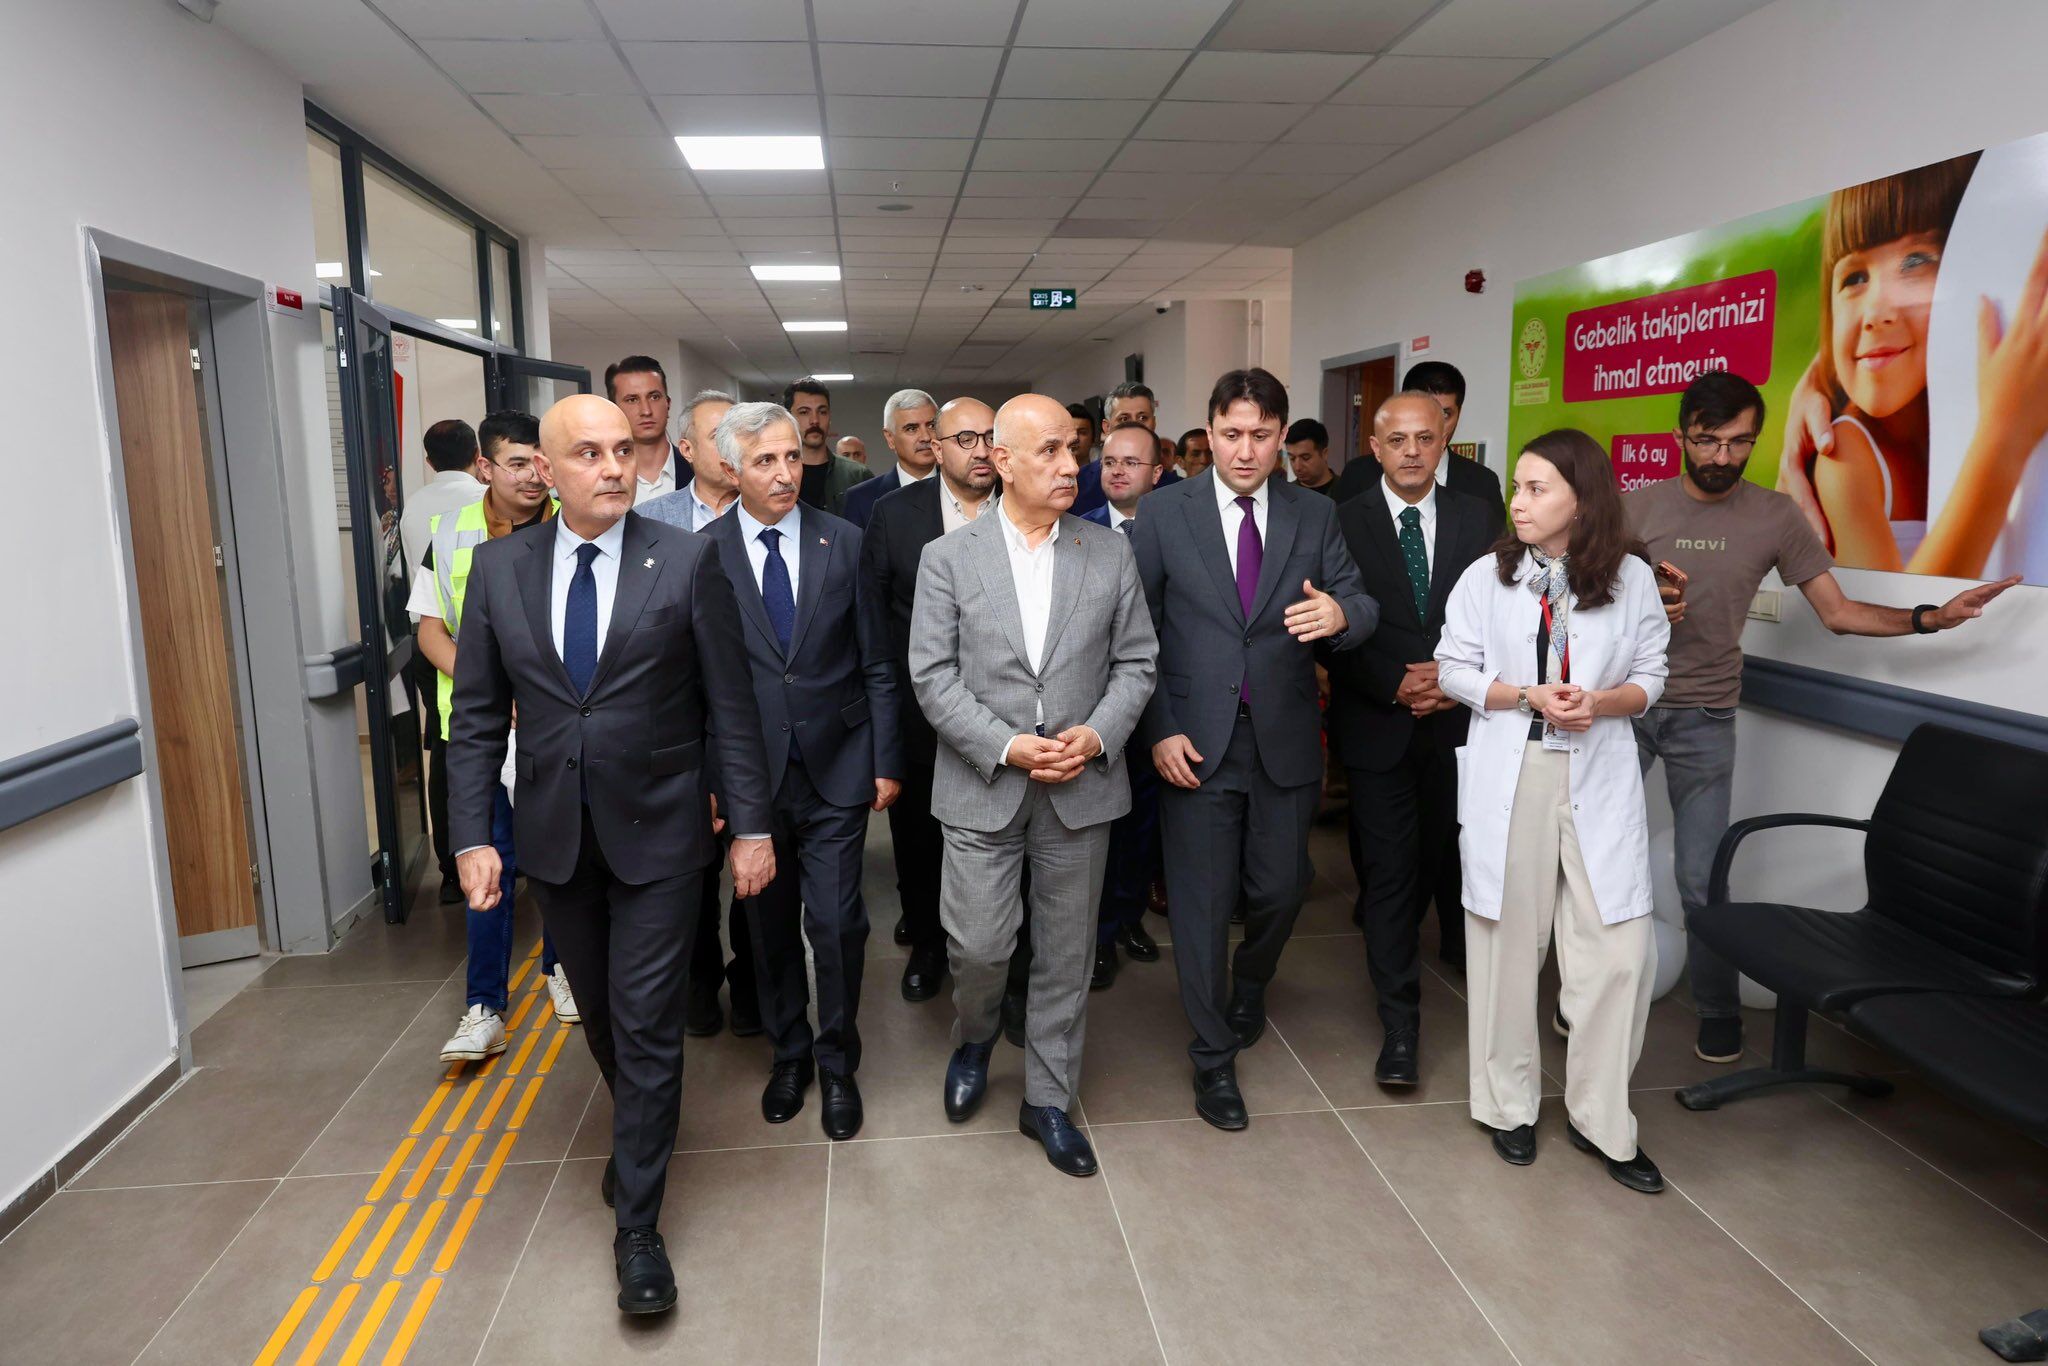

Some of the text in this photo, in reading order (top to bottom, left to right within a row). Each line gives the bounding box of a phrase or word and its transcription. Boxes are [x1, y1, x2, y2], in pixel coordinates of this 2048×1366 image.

[1574, 288, 1765, 351] Gebelik takiplerinizi
[1593, 358, 1641, 392] ihmal
[1639, 443, 1648, 463] 6
[1651, 448, 1668, 467] ay
[1675, 537, 1726, 551] mavi
